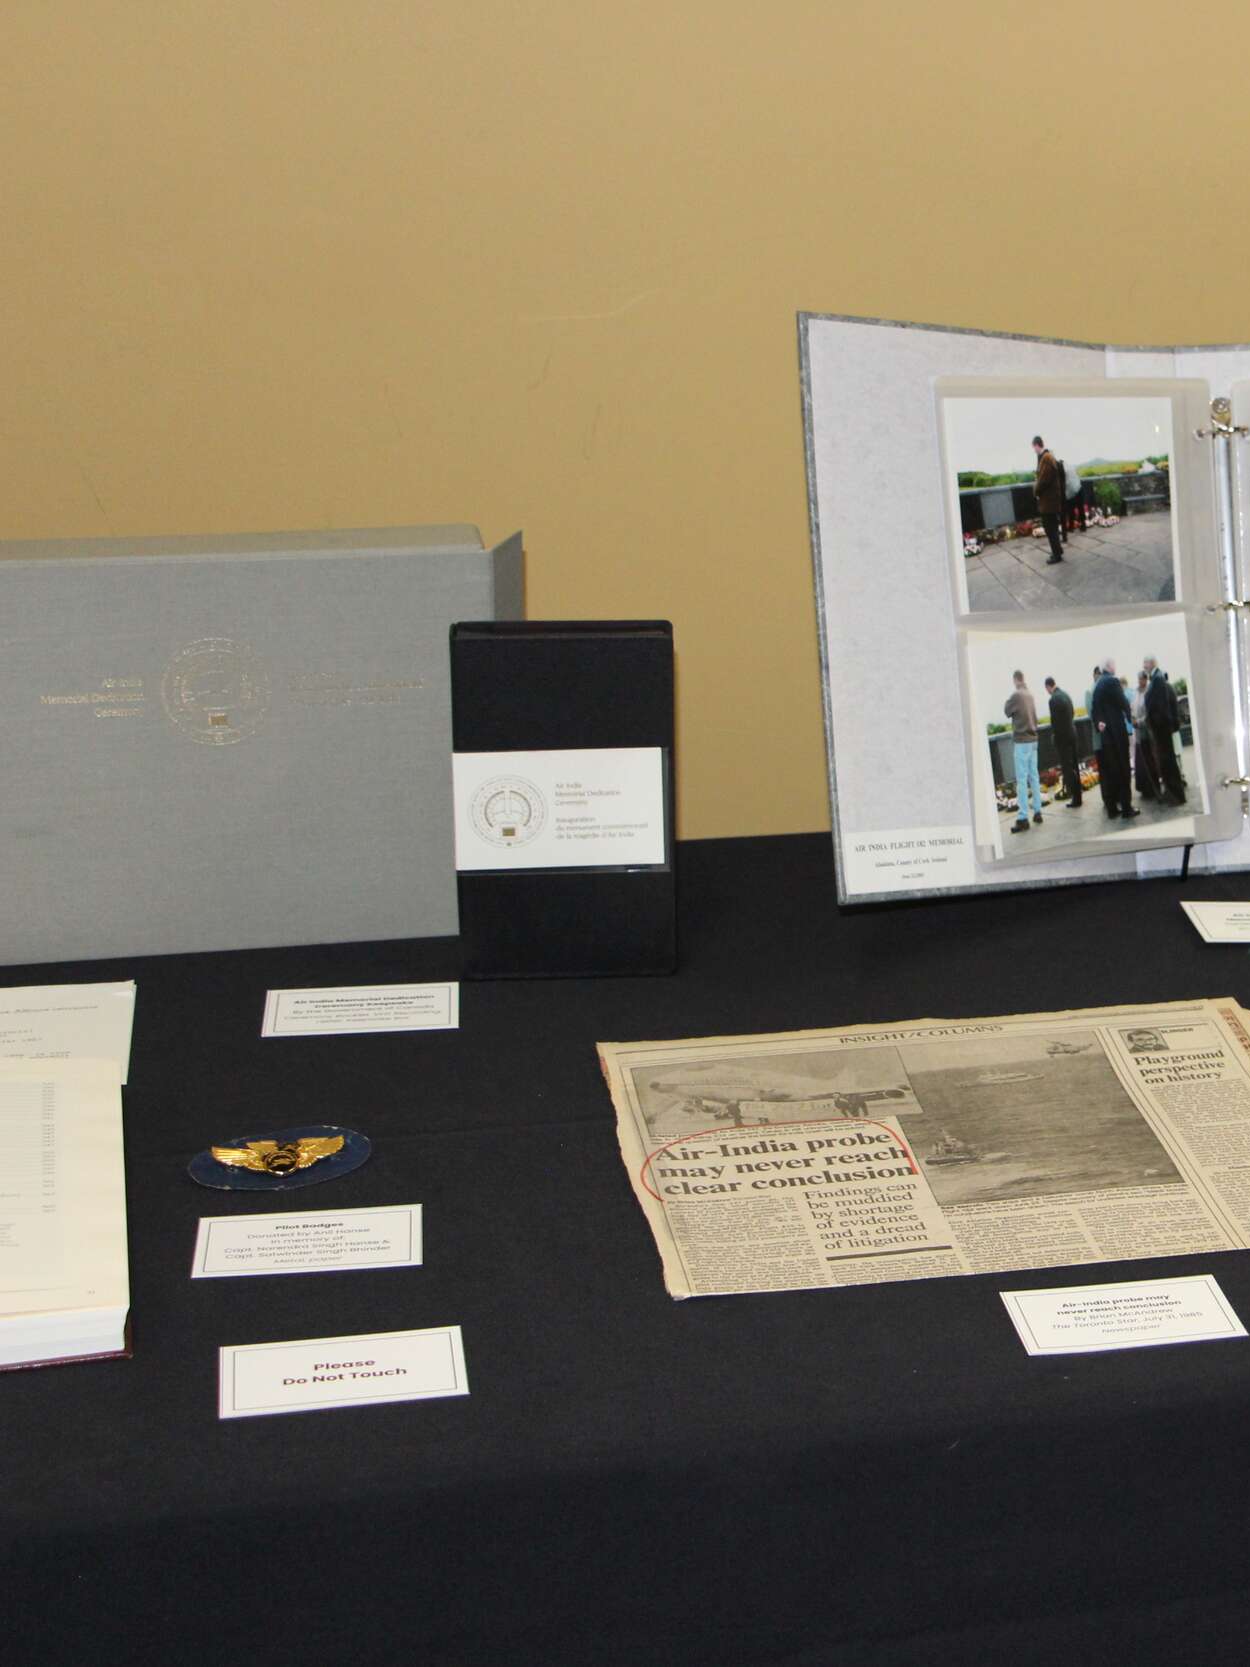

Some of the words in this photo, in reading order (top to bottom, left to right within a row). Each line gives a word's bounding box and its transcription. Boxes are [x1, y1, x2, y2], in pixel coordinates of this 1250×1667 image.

[839, 1025, 1003, 1044] INSIGHT/COLUMNS
[1134, 1050, 1224, 1065] Playground
[1139, 1061, 1224, 1077] perspective
[1166, 1070, 1221, 1083] history
[656, 1137, 797, 1161] Air-India
[804, 1131, 892, 1153] probe
[657, 1165, 725, 1180] may
[735, 1157, 815, 1173] never
[824, 1147, 910, 1166] reach
[663, 1177, 742, 1196] clear
[750, 1164, 915, 1190] conclusion
[802, 1186, 883, 1200] Findings
[886, 1182, 918, 1192] can
[807, 1198, 824, 1209] be
[827, 1191, 914, 1207] muddied
[811, 1208, 835, 1221] by
[838, 1202, 915, 1217] shortage
[301, 1221, 344, 1230] Badges
[815, 1218, 836, 1230] of
[838, 1213, 919, 1229] evidence
[819, 1227, 854, 1240] and
[859, 1228, 871, 1236] a
[874, 1221, 927, 1235] dread
[824, 1238, 844, 1250] of
[847, 1232, 929, 1248] litigation
[1089, 1305, 1121, 1313] reach
[1122, 1300, 1181, 1310] conclusion
[1112, 1296, 1144, 1305] probe
[1145, 1294, 1169, 1302] may
[313, 1359, 376, 1371] Please
[282, 1377, 308, 1386] Do
[312, 1374, 344, 1383] Not
[348, 1368, 407, 1380] Touch
